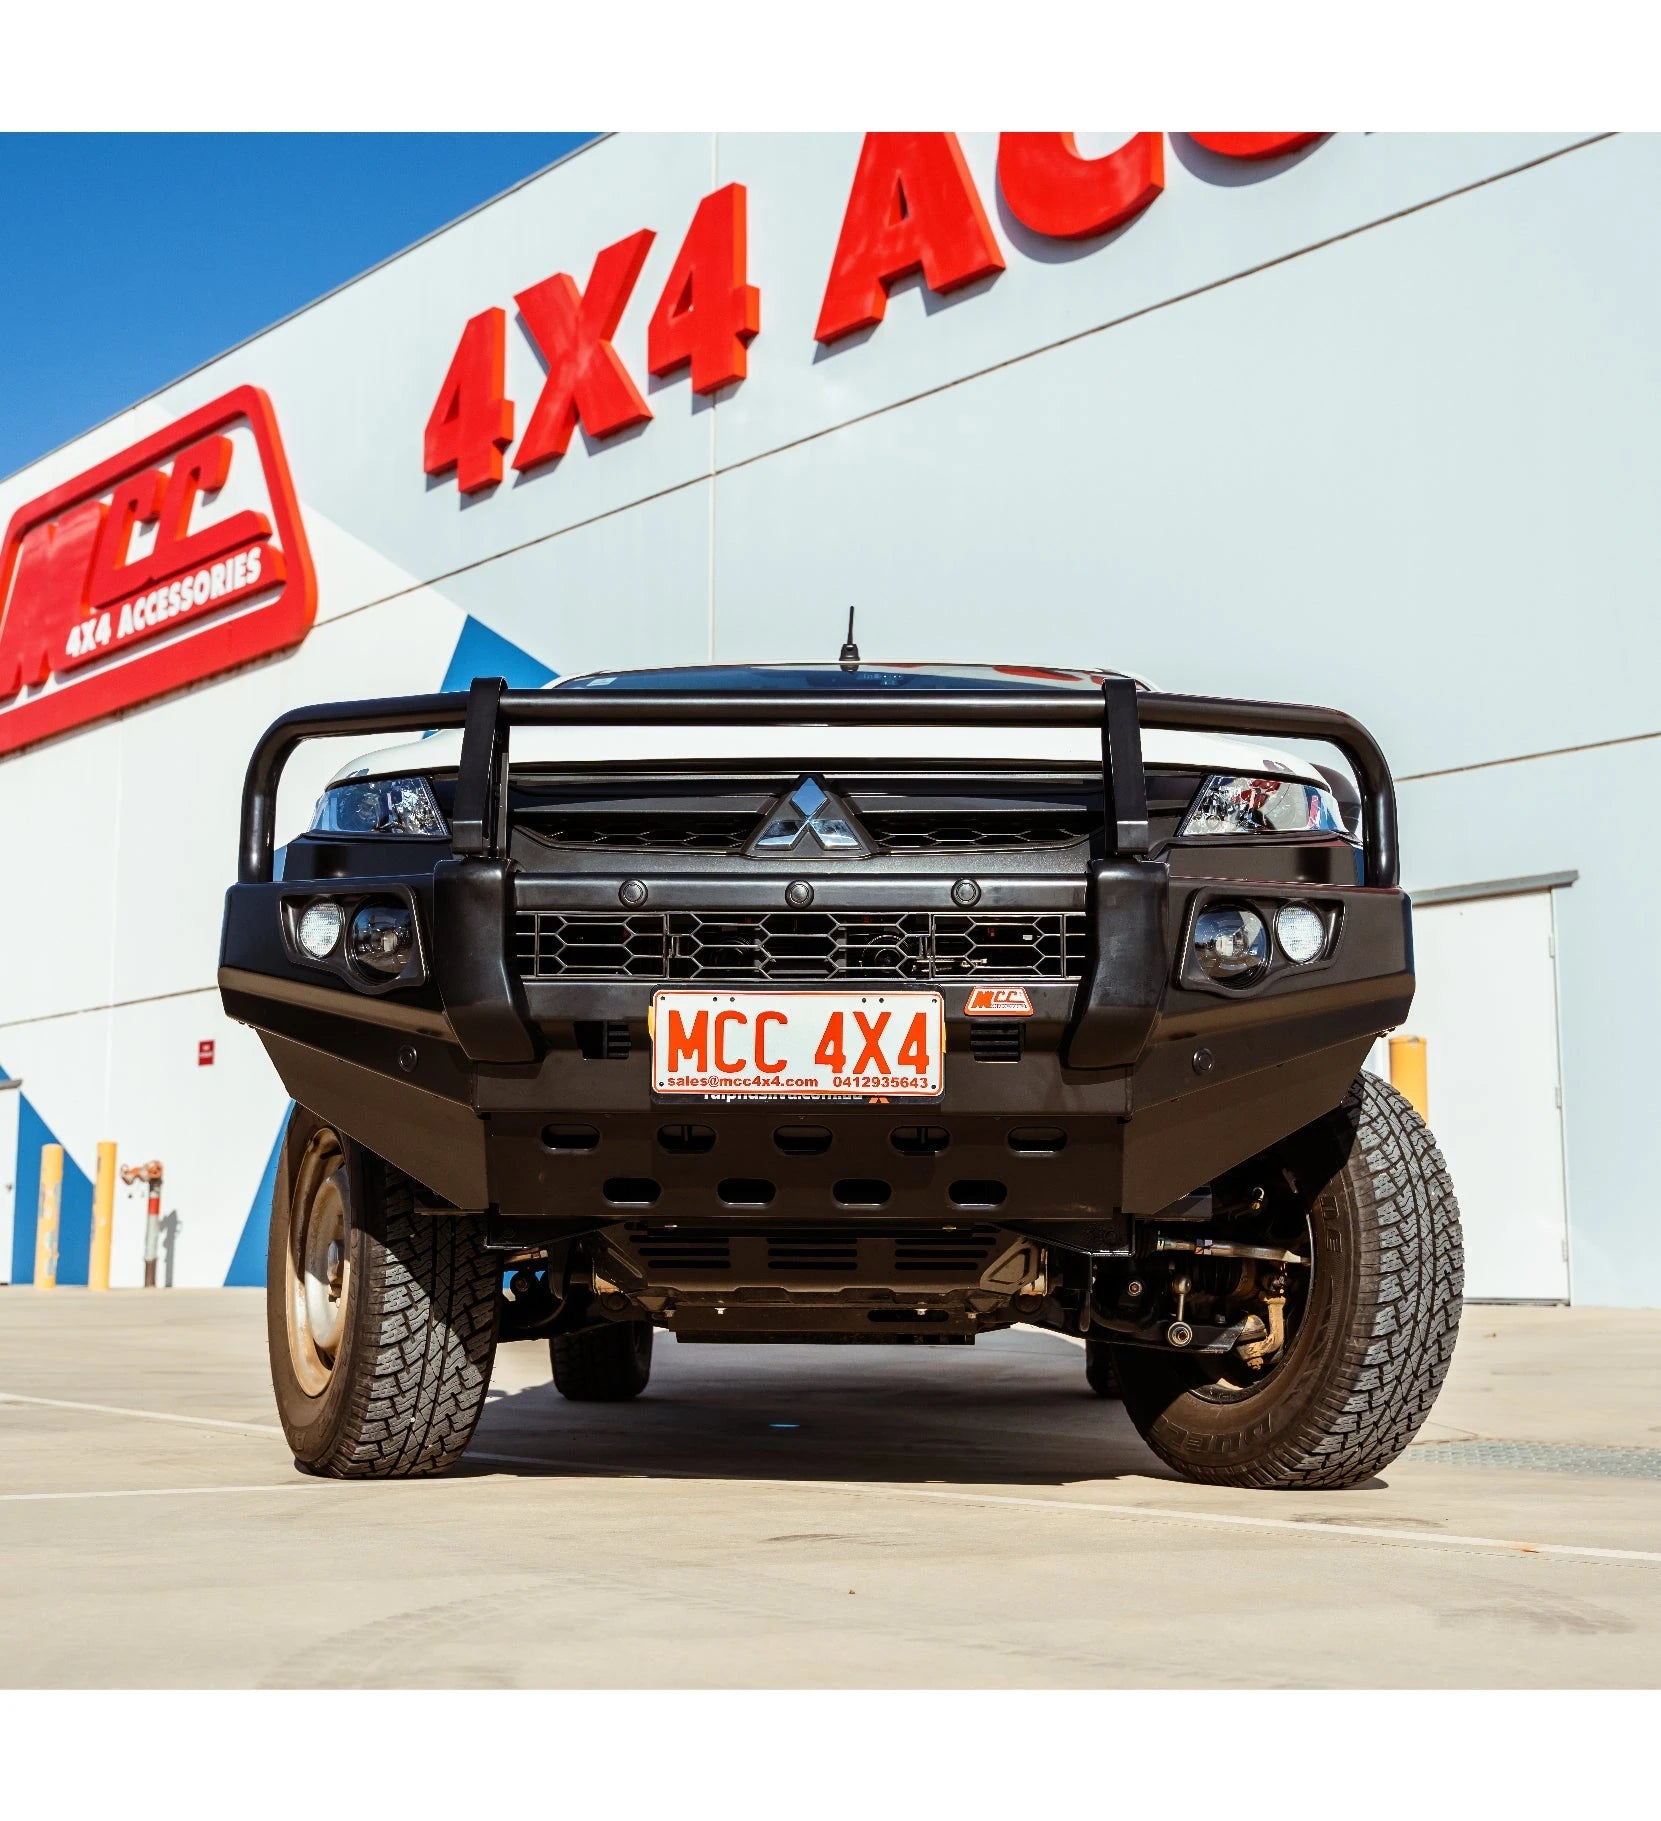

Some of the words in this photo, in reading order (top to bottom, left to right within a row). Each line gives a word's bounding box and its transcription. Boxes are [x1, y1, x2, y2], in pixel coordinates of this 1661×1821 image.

[423, 181, 759, 496] 4X4
[0, 435, 272, 697] MCC
[65, 612, 111, 658] 4X4
[117, 546, 262, 639] ACCESSORIES
[667, 1009, 788, 1074] MCC
[814, 1011, 930, 1075] 4X4
[970, 990, 1025, 1008] MCC
[667, 1075, 819, 1088] sales@mcc4x4.com
[832, 1076, 929, 1090] 0412935643
